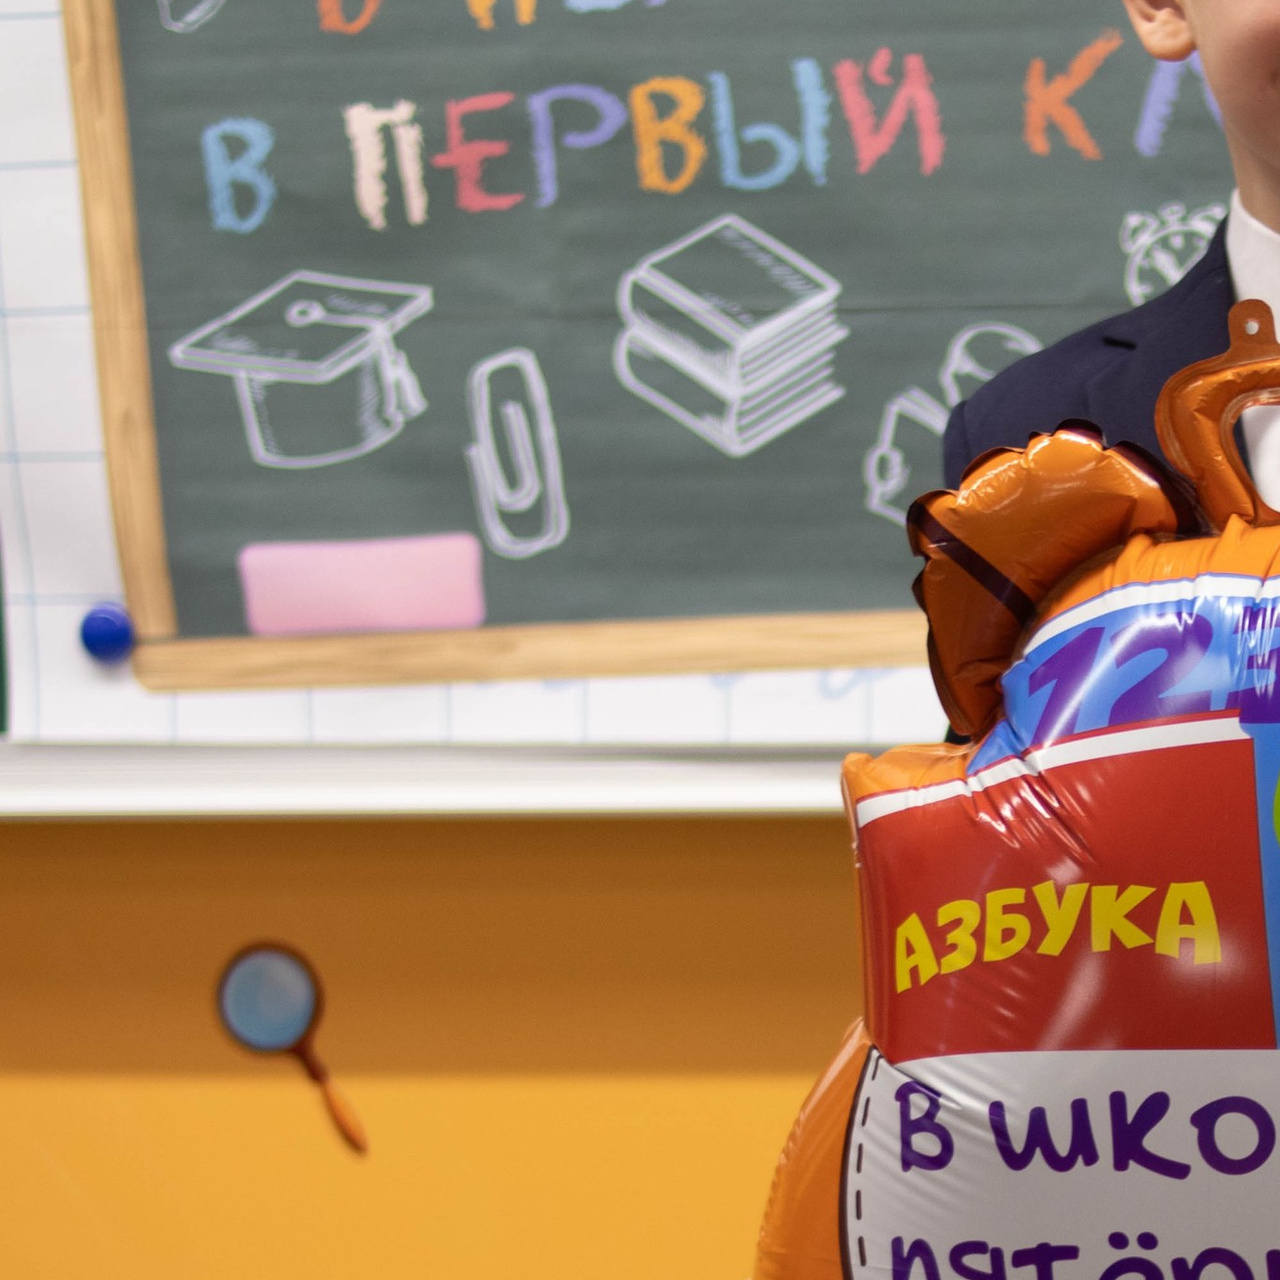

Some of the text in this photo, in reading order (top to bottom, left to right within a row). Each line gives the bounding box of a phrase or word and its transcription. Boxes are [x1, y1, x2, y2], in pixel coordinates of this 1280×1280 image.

[202, 117, 276, 233] В
[342, 47, 946, 230] ПЕРВЫЙ
[895, 880, 1222, 994] АЗБУКА
